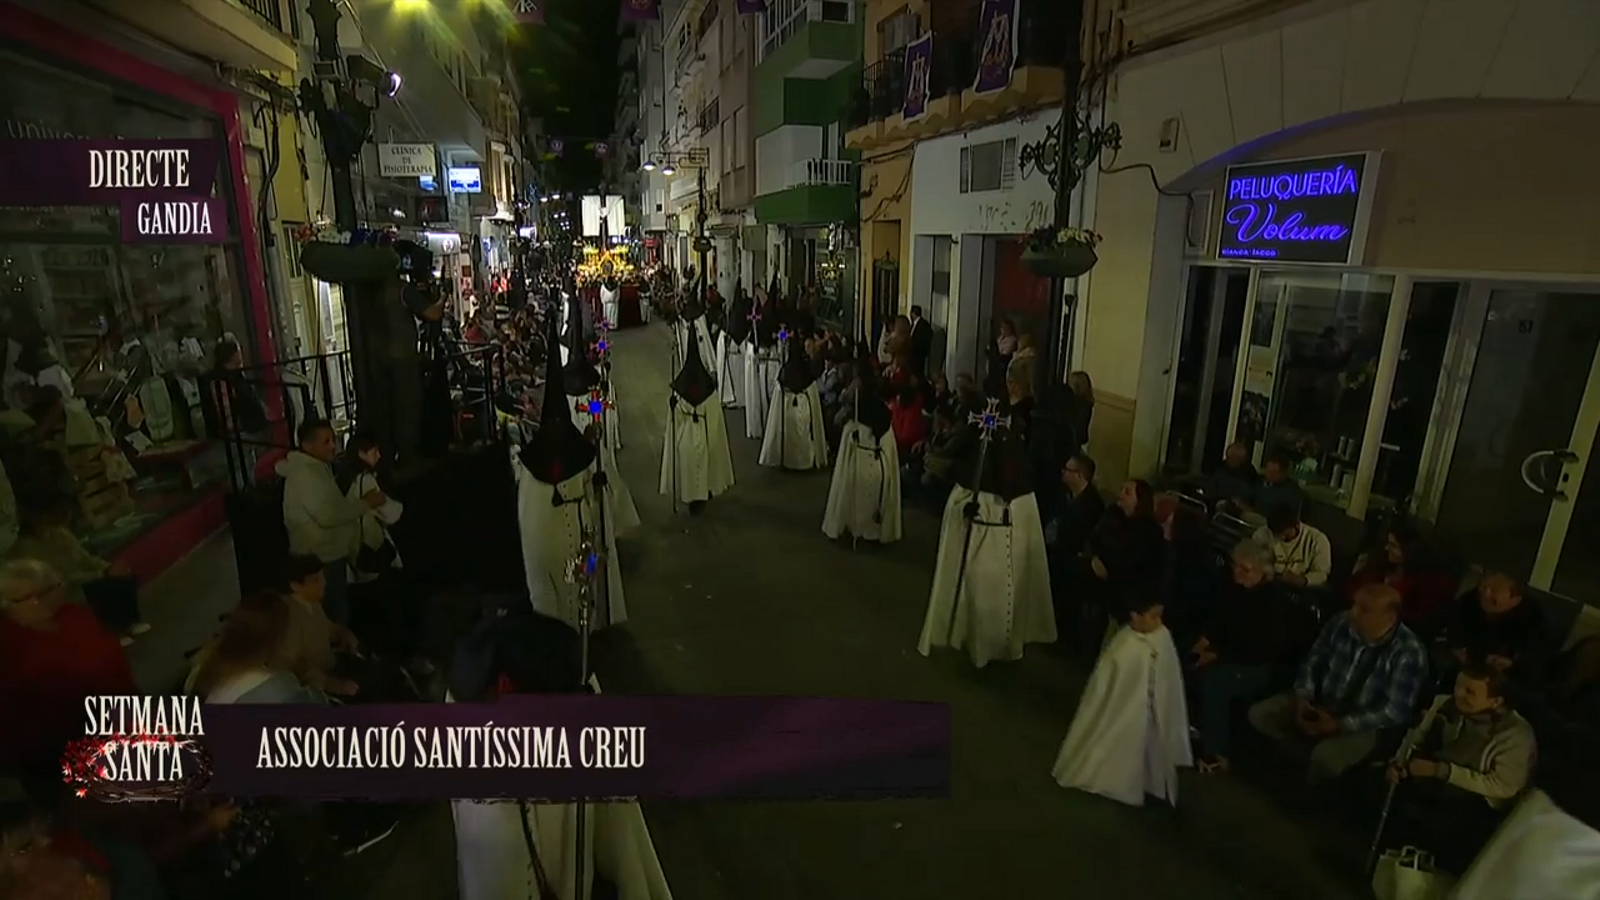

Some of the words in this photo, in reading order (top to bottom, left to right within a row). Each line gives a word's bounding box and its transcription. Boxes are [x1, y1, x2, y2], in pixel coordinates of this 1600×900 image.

[384, 164, 433, 174] FISIOTERAPIA
[1229, 164, 1357, 200] PELUQUERÍA
[1226, 202, 1349, 242] Volum
